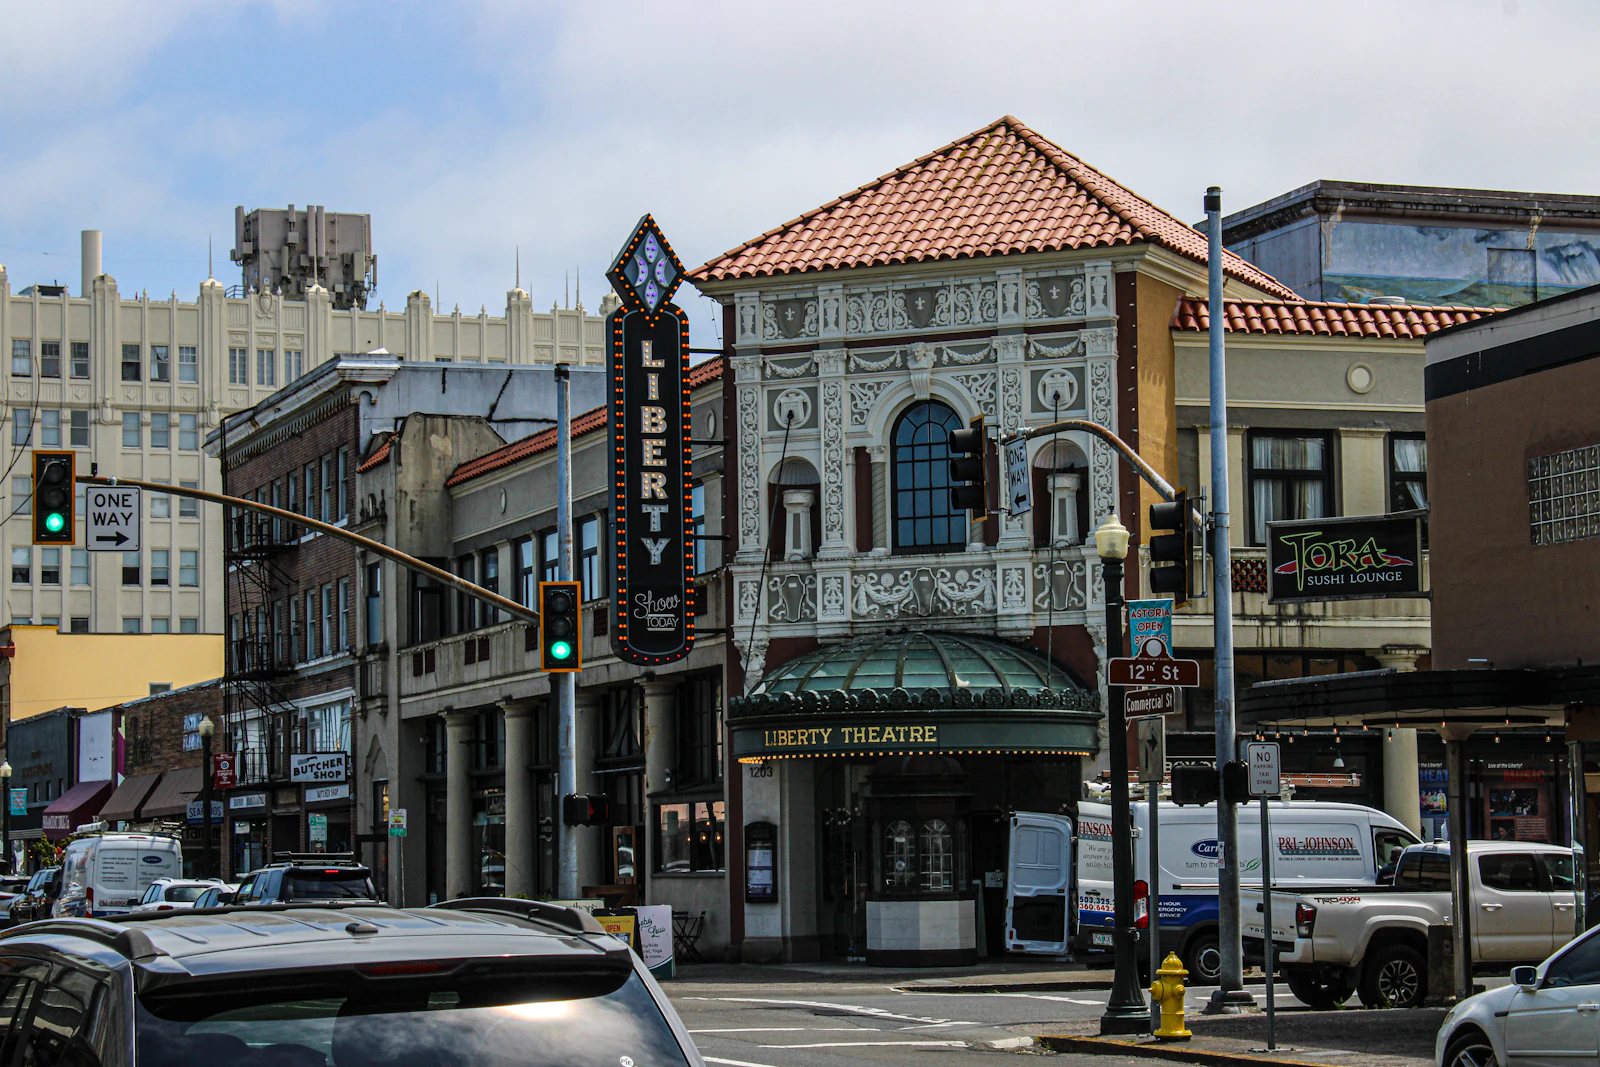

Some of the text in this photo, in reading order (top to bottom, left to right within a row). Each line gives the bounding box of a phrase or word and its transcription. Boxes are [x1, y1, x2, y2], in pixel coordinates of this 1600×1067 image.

[641, 340, 671, 565] LIBERTY
[1010, 446, 1024, 466] ONE
[1010, 467, 1026, 488] WAY
[94, 493, 133, 508] ONE
[92, 512, 133, 526] WAY
[1307, 571, 1402, 586] SUSHI LOUNGE
[633, 589, 681, 619] Show
[1130, 608, 1171, 618] ASTORIA
[645, 617, 679, 628] TODAY
[1137, 622, 1163, 632] OPEN
[1129, 664, 1179, 680] 12th St
[1126, 692, 1173, 713] Commercial St
[764, 725, 938, 747] LIBERTY THEATRE
[1256, 751, 1271, 762] NO
[293, 757, 343, 776] BUTCHER
[749, 766, 774, 778] 1203
[313, 770, 342, 780] SHOP
[1418, 769, 1449, 782] HEAT
[1503, 769, 1546, 783] MUSIC
[1249, 927, 1285, 936] TACMA
